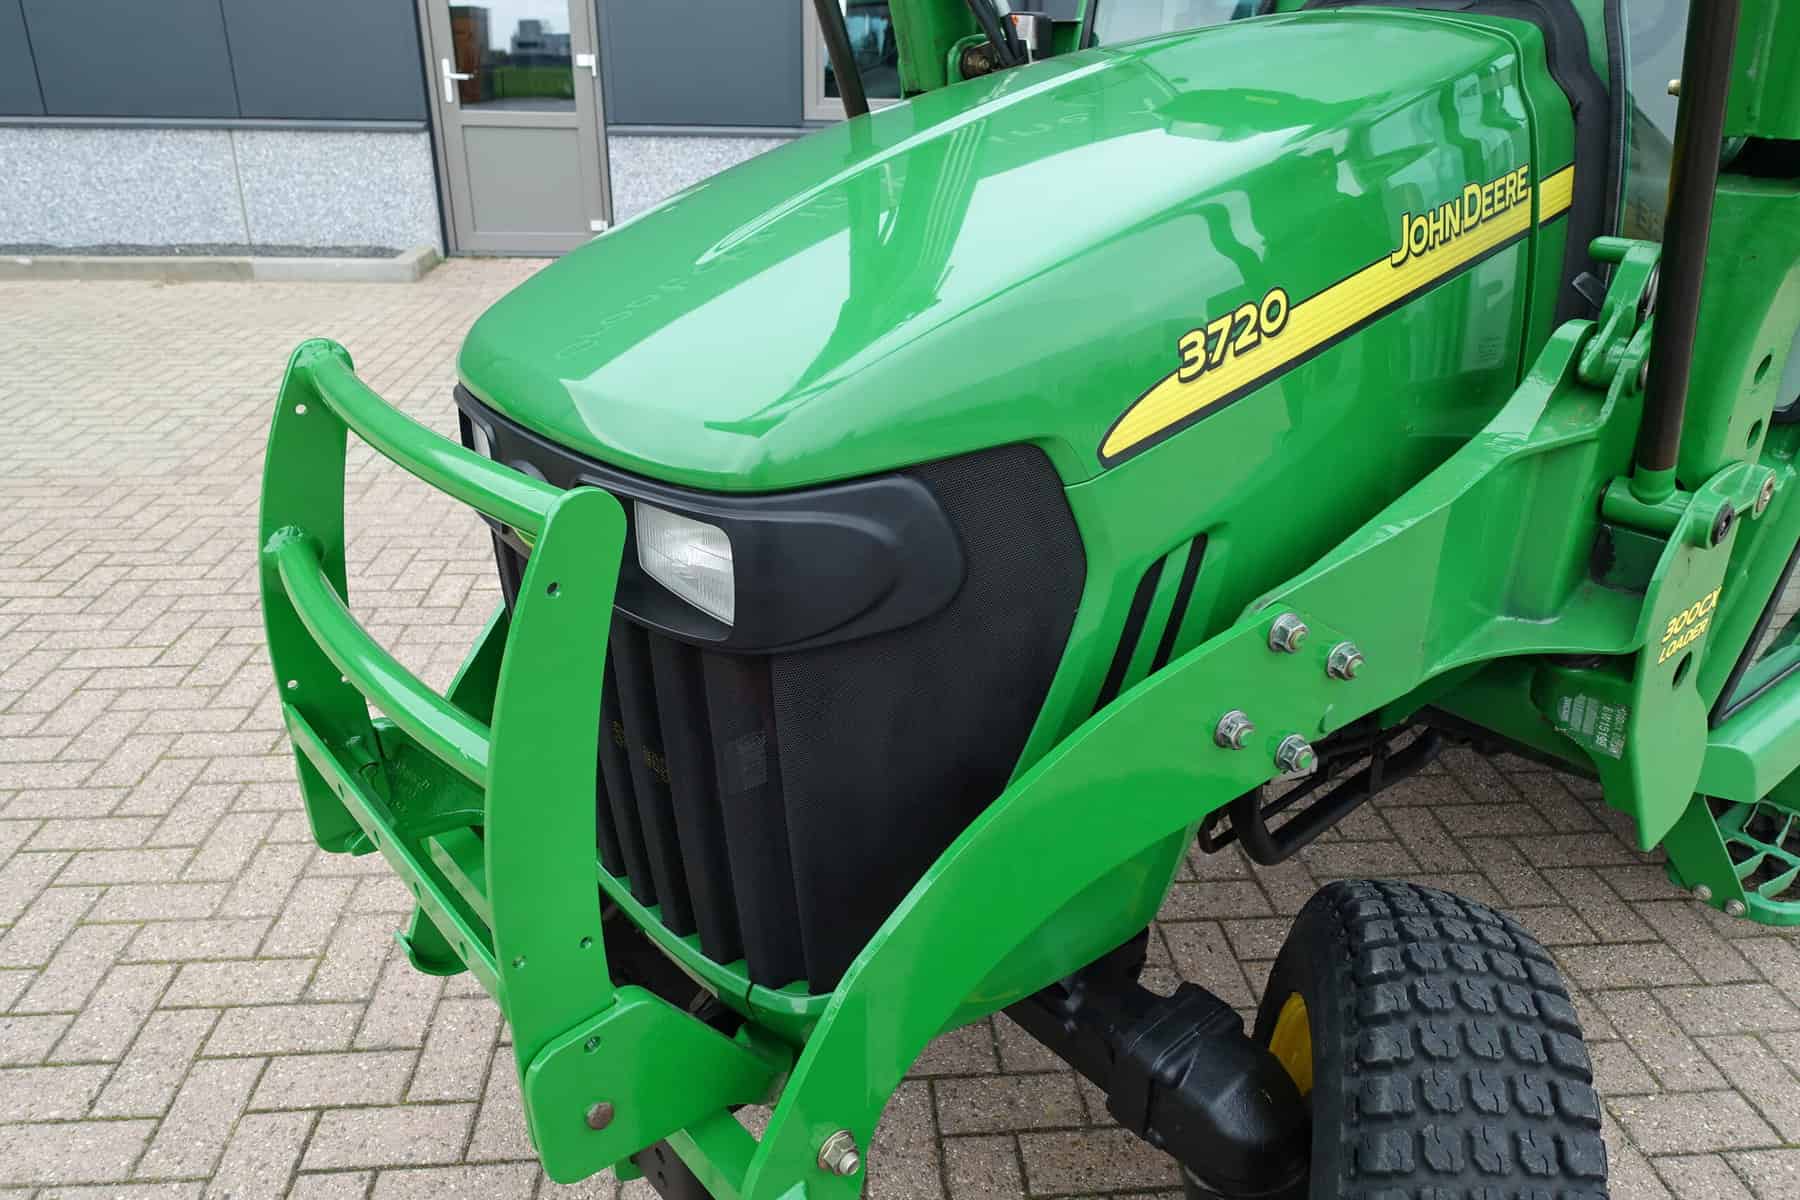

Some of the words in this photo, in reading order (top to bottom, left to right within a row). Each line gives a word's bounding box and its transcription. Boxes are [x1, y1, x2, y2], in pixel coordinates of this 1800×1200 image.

[1391, 196, 1462, 268] JOHN
[1463, 163, 1530, 232] DEERE
[1178, 287, 1290, 384] 3720
[1658, 617, 1709, 665] LOADER
